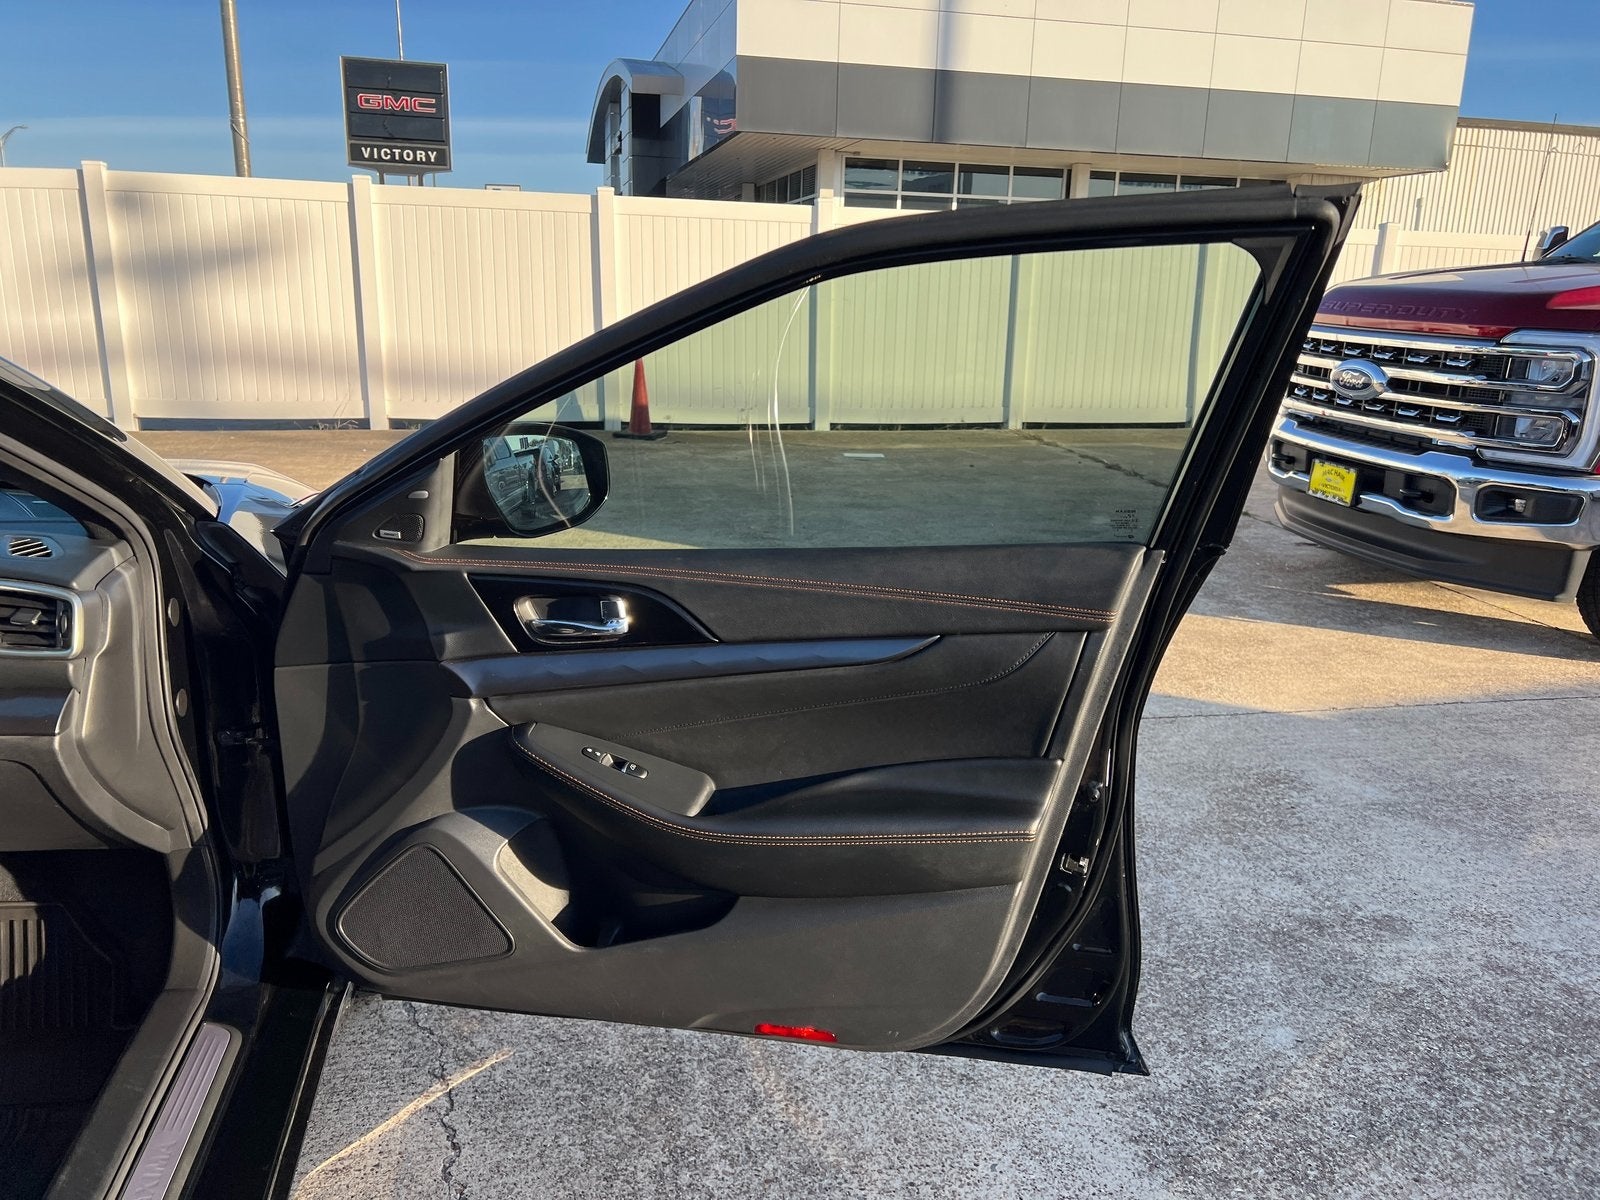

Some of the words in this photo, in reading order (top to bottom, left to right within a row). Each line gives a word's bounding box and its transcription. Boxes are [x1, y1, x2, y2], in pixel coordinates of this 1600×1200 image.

[357, 93, 437, 113] GMC
[361, 146, 437, 162] VICTORY
[1321, 300, 1393, 314] SUPER
[1396, 304, 1478, 320] DUTY
[1340, 370, 1366, 388] Ford
